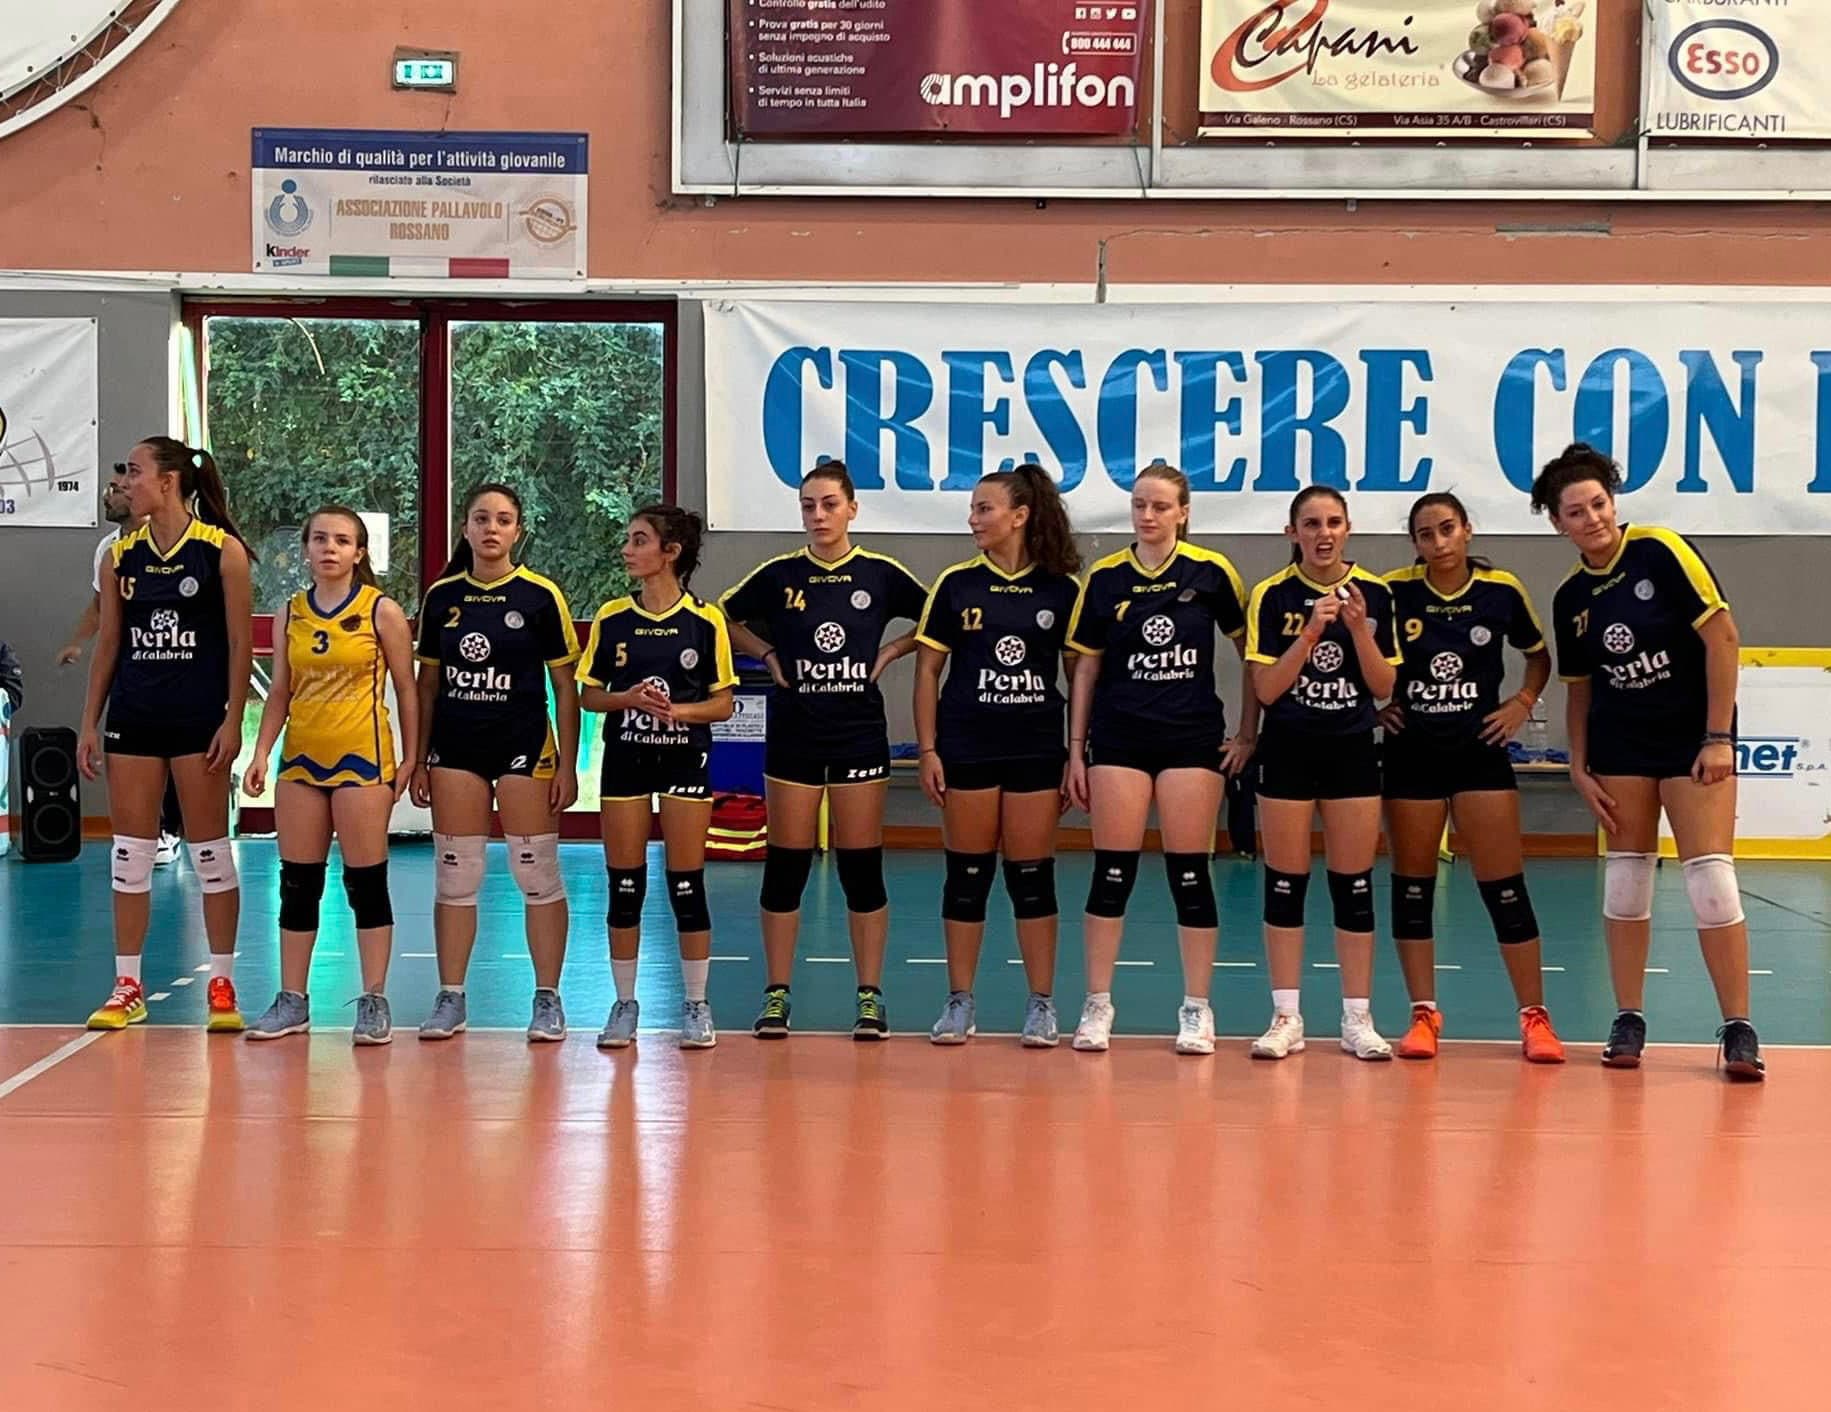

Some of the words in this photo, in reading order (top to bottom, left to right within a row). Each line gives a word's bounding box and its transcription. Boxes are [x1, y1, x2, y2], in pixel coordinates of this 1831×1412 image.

[807, 0, 836, 10] gratis
[759, 19, 788, 29] Prova
[790, 20, 818, 31] gratis
[821, 21, 838, 31] per
[840, 20, 851, 30] 30
[854, 20, 884, 31] giorni
[759, 33, 786, 41] senza
[790, 33, 833, 43] impegno
[836, 32, 846, 41] di
[849, 33, 890, 43] acquisto
[1071, 38, 1091, 49] 800
[1093, 38, 1110, 50] 444
[1113, 38, 1131, 50] 444
[759, 52, 805, 62] Soluzioni
[807, 53, 853, 62] acustiche
[758, 66, 768, 75] di
[771, 66, 801, 75] ultima
[804, 67, 865, 77] generazione
[1312, 70, 1338, 86] La
[1344, 71, 1440, 90] gelateria
[759, 86, 792, 96] Servizi
[794, 87, 823, 96] senza
[825, 86, 850, 95] limiti
[920, 62, 1135, 119] amplifon
[758, 98, 768, 107] di
[770, 99, 801, 109] tempo
[805, 98, 814, 107] in
[817, 98, 839, 107] tutta
[842, 98, 866, 107] Italia
[1224, 114, 1240, 125] Via
[1243, 114, 1280, 125] Galeno
[1289, 115, 1332, 125] Rossano
[1335, 114, 1357, 126] (CS)
[1394, 115, 1409, 125] Via
[1412, 115, 1434, 125] Asia
[1436, 116, 1449, 125] 35
[1543, 115, 1566, 126] (CS)
[1656, 112, 1785, 132] LUBRIFICANTI
[275, 147, 333, 164] Marchio
[338, 149, 351, 164] di
[356, 149, 405, 168] qualità
[409, 153, 432, 169] per
[437, 151, 496, 167] l'attività
[500, 152, 566, 170] giovanile
[369, 175, 413, 186] rilasciato
[416, 176, 433, 186] alla
[435, 176, 471, 187] Società
[336, 199, 427, 218] ASSOCIAZIONE
[432, 201, 503, 219] PALLAVOLO
[390, 223, 450, 240] ROSSANO
[763, 346, 1434, 494] CRESCERE
[1494, 347, 1763, 494] CON
[58, 481, 79, 492] 1974
[464, 594, 507, 602] GIVOVA
[784, 587, 807, 612] 24
[444, 606, 461, 628] 2
[961, 607, 983, 630] 12
[1281, 612, 1305, 636] 22
[130, 625, 197, 648] Perla
[1405, 617, 1423, 642] 9
[311, 630, 330, 655] 3
[615, 642, 627, 667] 5
[1127, 643, 1198, 670] Perla
[446, 665, 512, 690] Perla
[796, 655, 867, 680] Perla
[799, 682, 810, 693] di
[812, 681, 864, 693] Calabria
[977, 668, 1046, 692] Perla
[1407, 678, 1480, 701] Perla
[978, 692, 992, 703] di
[993, 692, 1045, 704] Calabria
[620, 731, 633, 742] di
[634, 732, 689, 745] Calabria
[510, 755, 528, 769] 2
